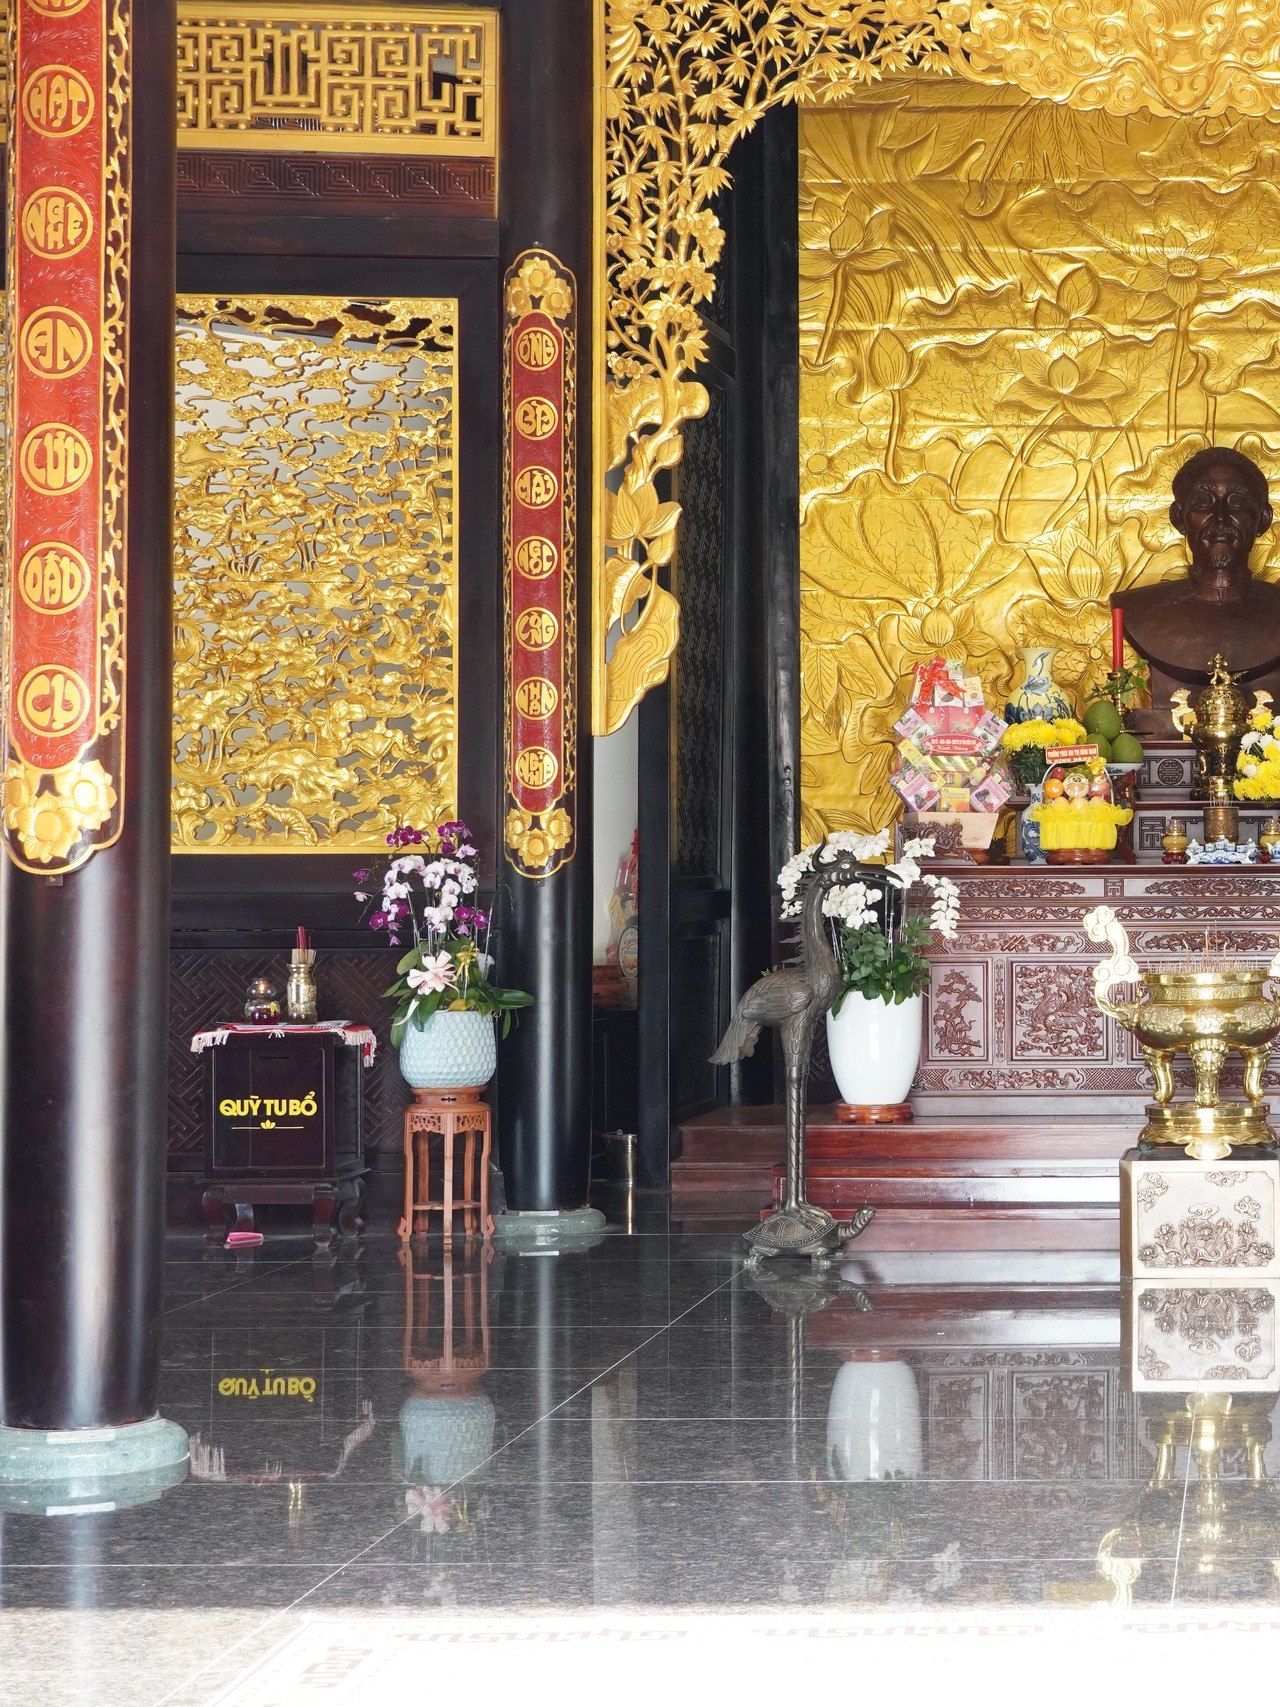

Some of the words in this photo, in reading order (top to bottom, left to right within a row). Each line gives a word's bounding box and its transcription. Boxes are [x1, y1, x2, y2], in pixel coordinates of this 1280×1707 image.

[30, 75, 86, 127] HẠT
[28, 318, 85, 371] AN
[219, 1095, 261, 1116] QUỸ
[264, 1099, 287, 1116] TU
[289, 1091, 317, 1116] BỔ
